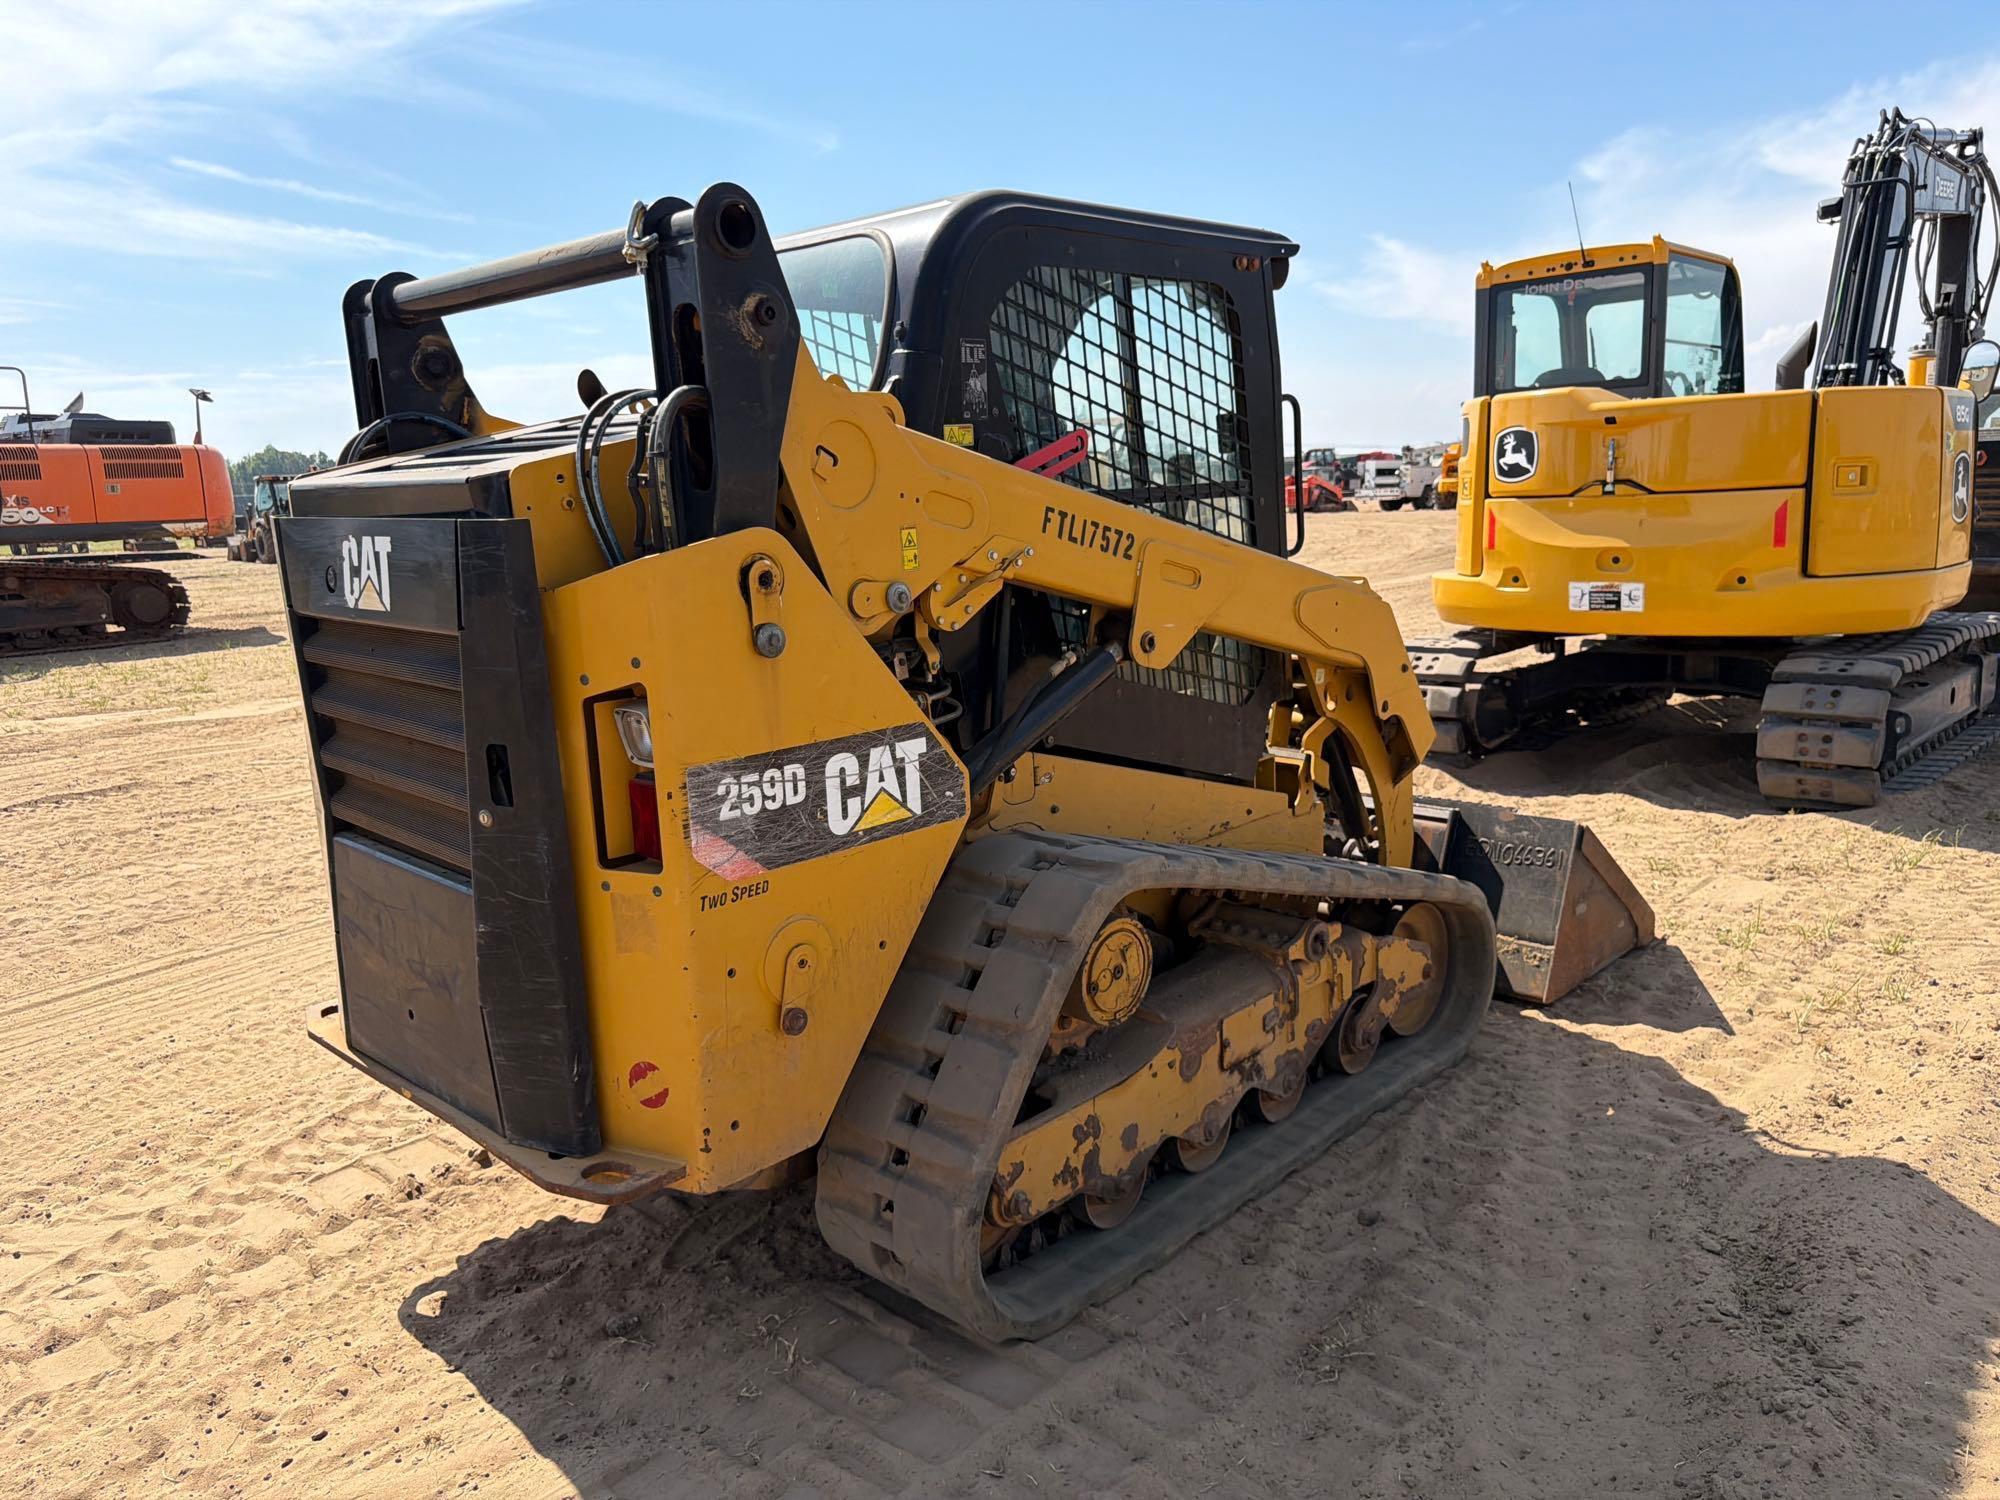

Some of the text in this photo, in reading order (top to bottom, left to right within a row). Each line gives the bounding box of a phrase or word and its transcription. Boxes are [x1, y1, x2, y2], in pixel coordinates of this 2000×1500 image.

[1935, 175, 1955, 199] DEERE
[1524, 281, 1560, 295] JOHN
[342, 534, 392, 612] CAT
[717, 763, 806, 821] 259D
[825, 737, 927, 836] CAT
